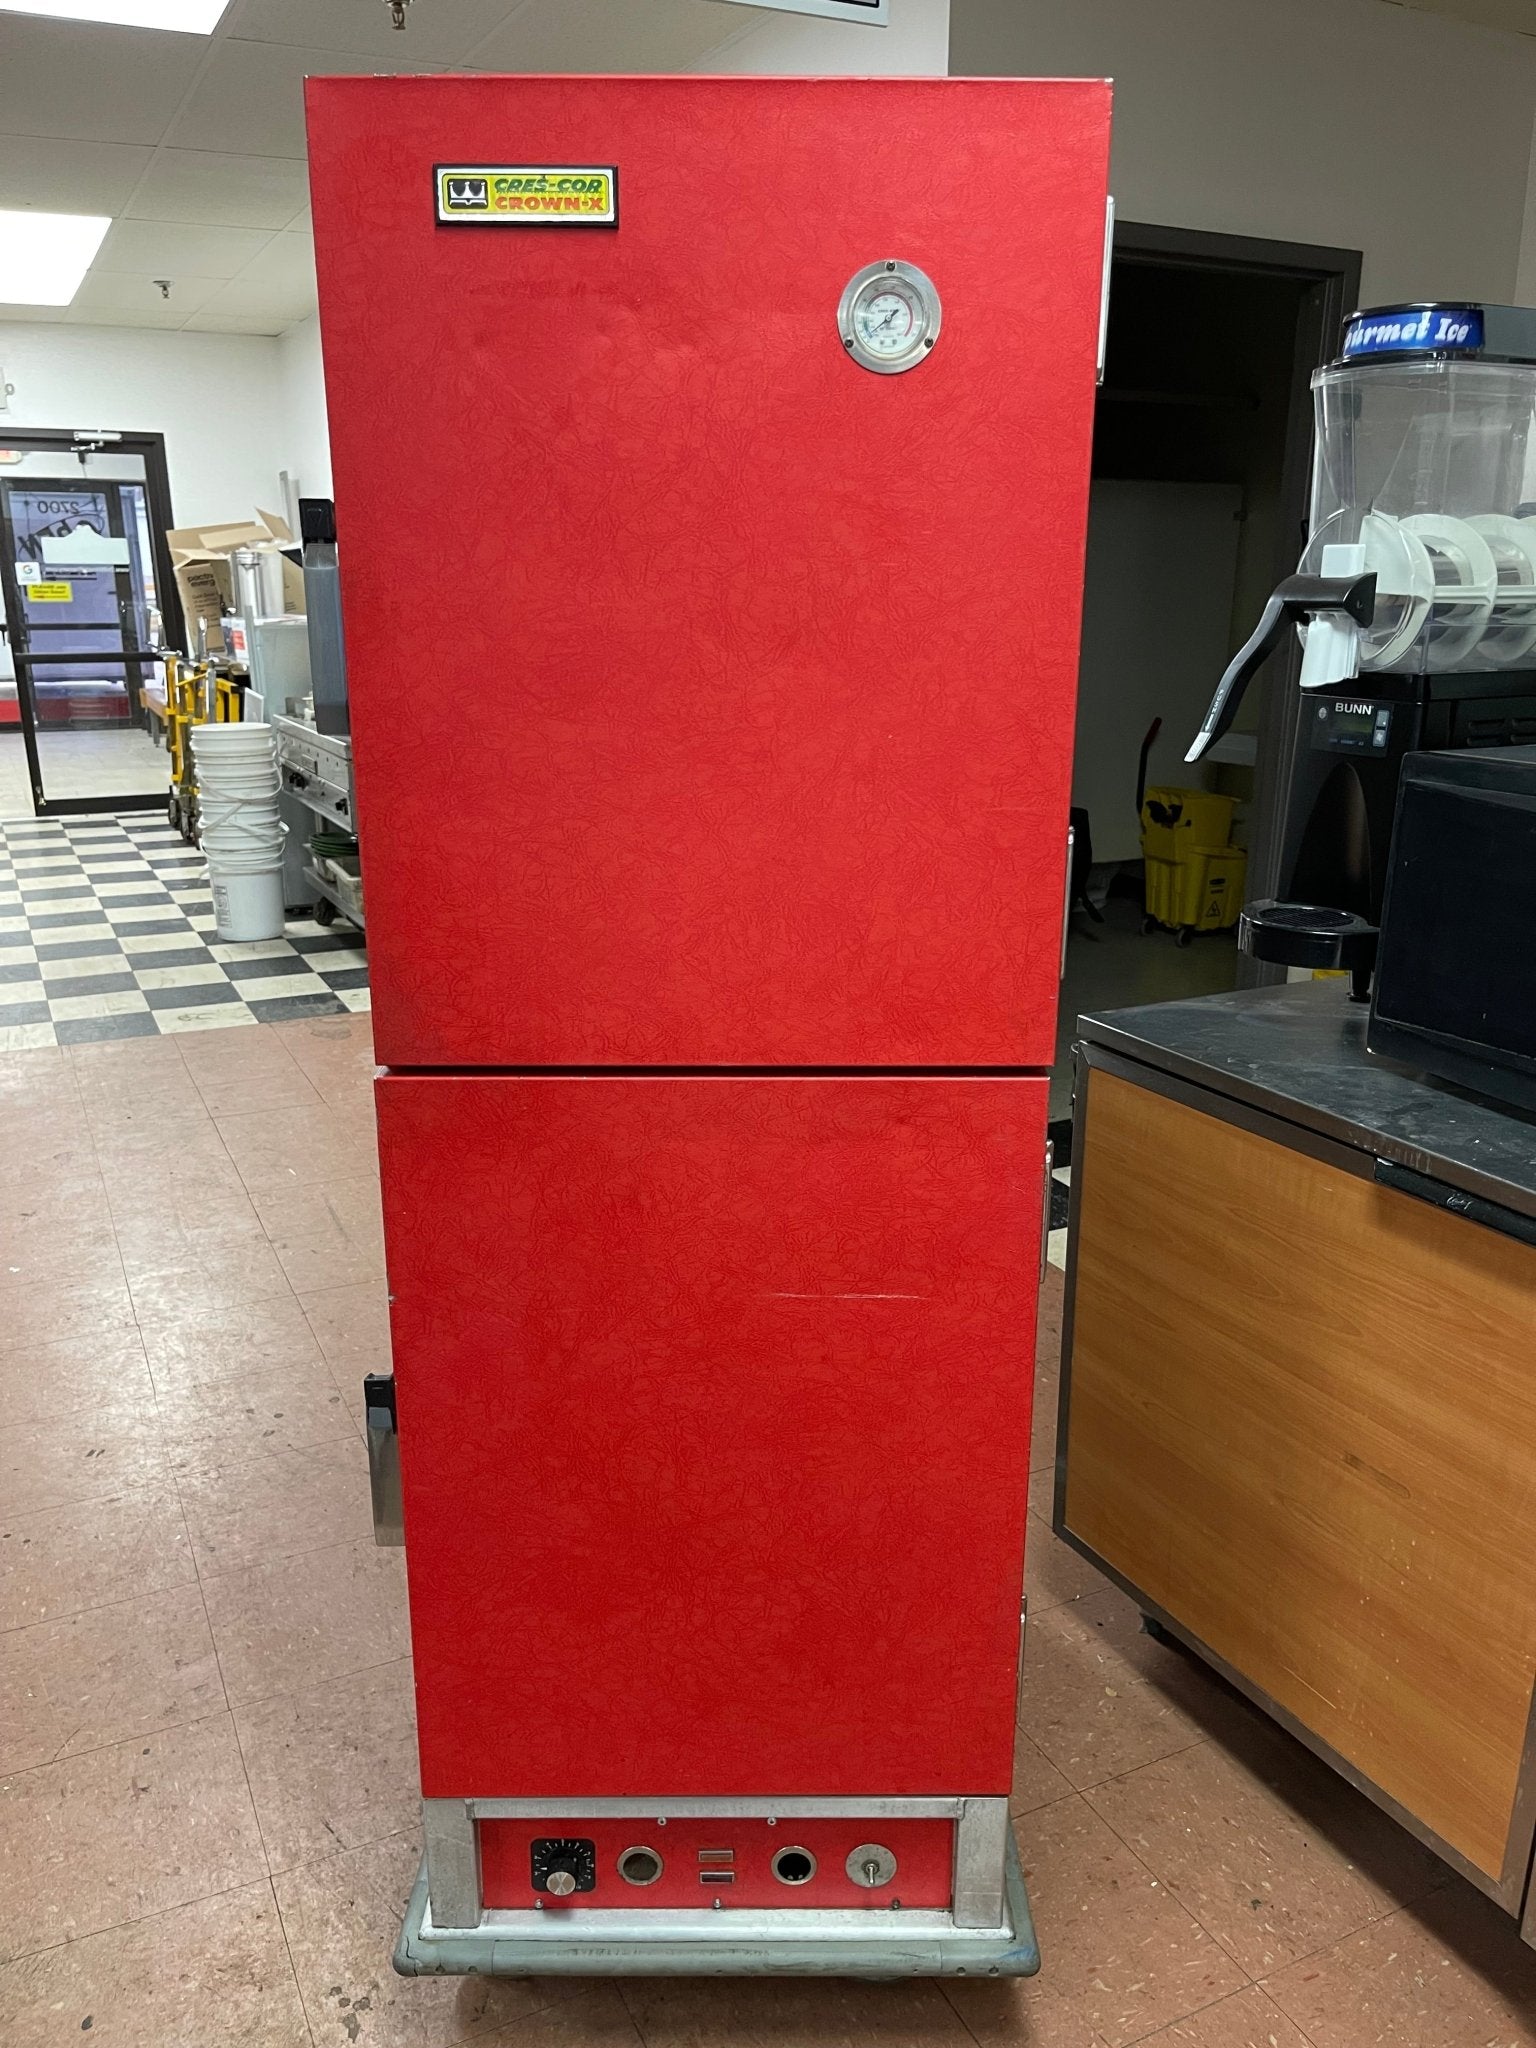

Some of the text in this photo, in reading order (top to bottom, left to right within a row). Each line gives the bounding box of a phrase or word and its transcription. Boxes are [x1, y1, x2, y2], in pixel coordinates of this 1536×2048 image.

[494, 178, 603, 193] CRES-COR
[494, 196, 604, 211] CROWN-X
[1434, 318, 1470, 343] Ice
[1335, 702, 1372, 715] BUNN
